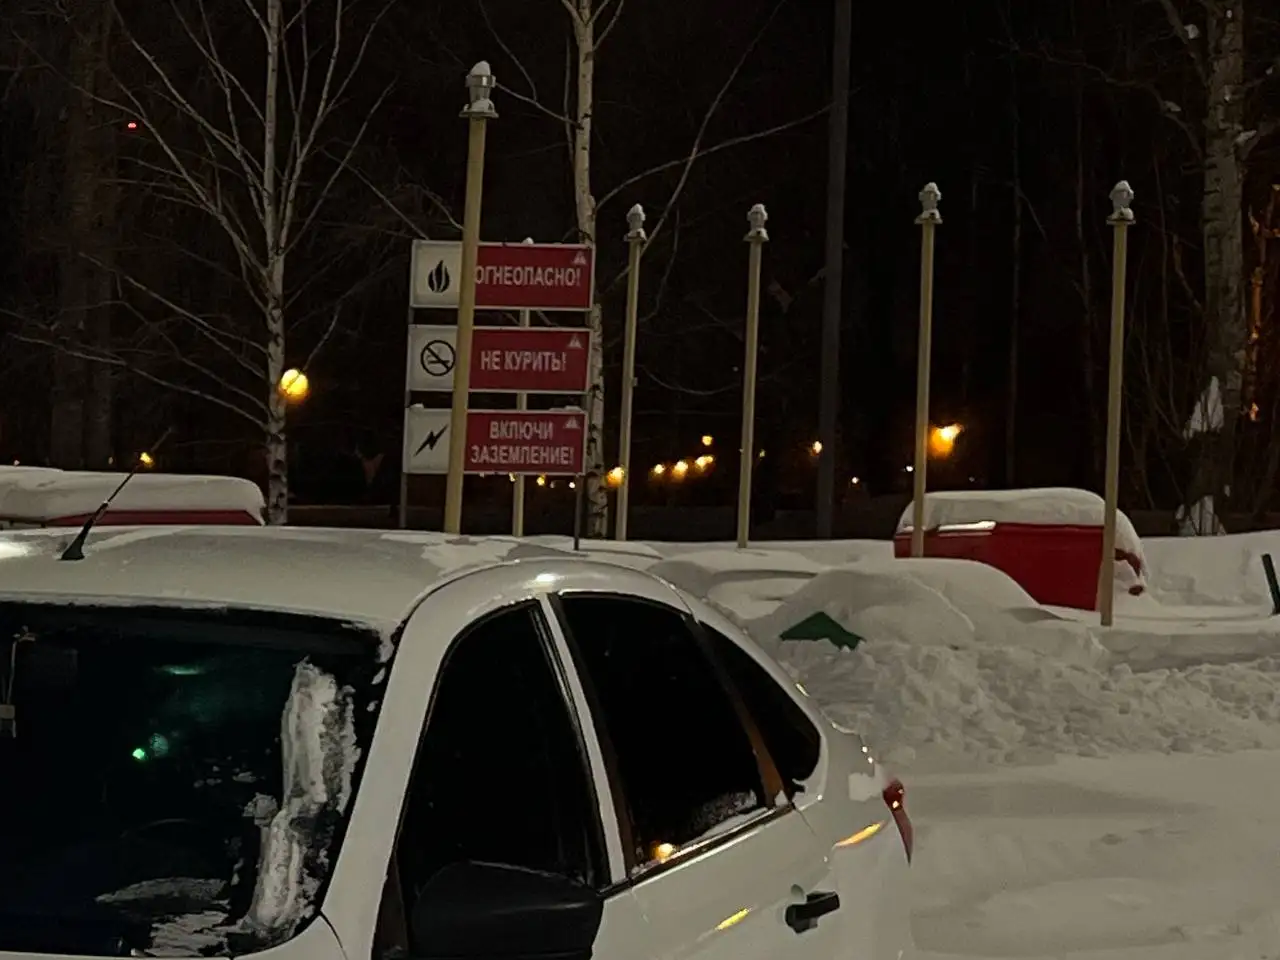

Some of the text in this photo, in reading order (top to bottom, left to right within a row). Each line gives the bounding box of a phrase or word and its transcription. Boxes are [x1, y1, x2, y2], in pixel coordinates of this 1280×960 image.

[474, 265, 581, 287] ОГНЕОПАСНО!
[480, 350, 567, 372] НЕ КУРИТЬ!
[489, 420, 554, 440] ВКЛЮЧИ
[471, 444, 575, 466] ЗАЗЕМЛЕНИЕ!
